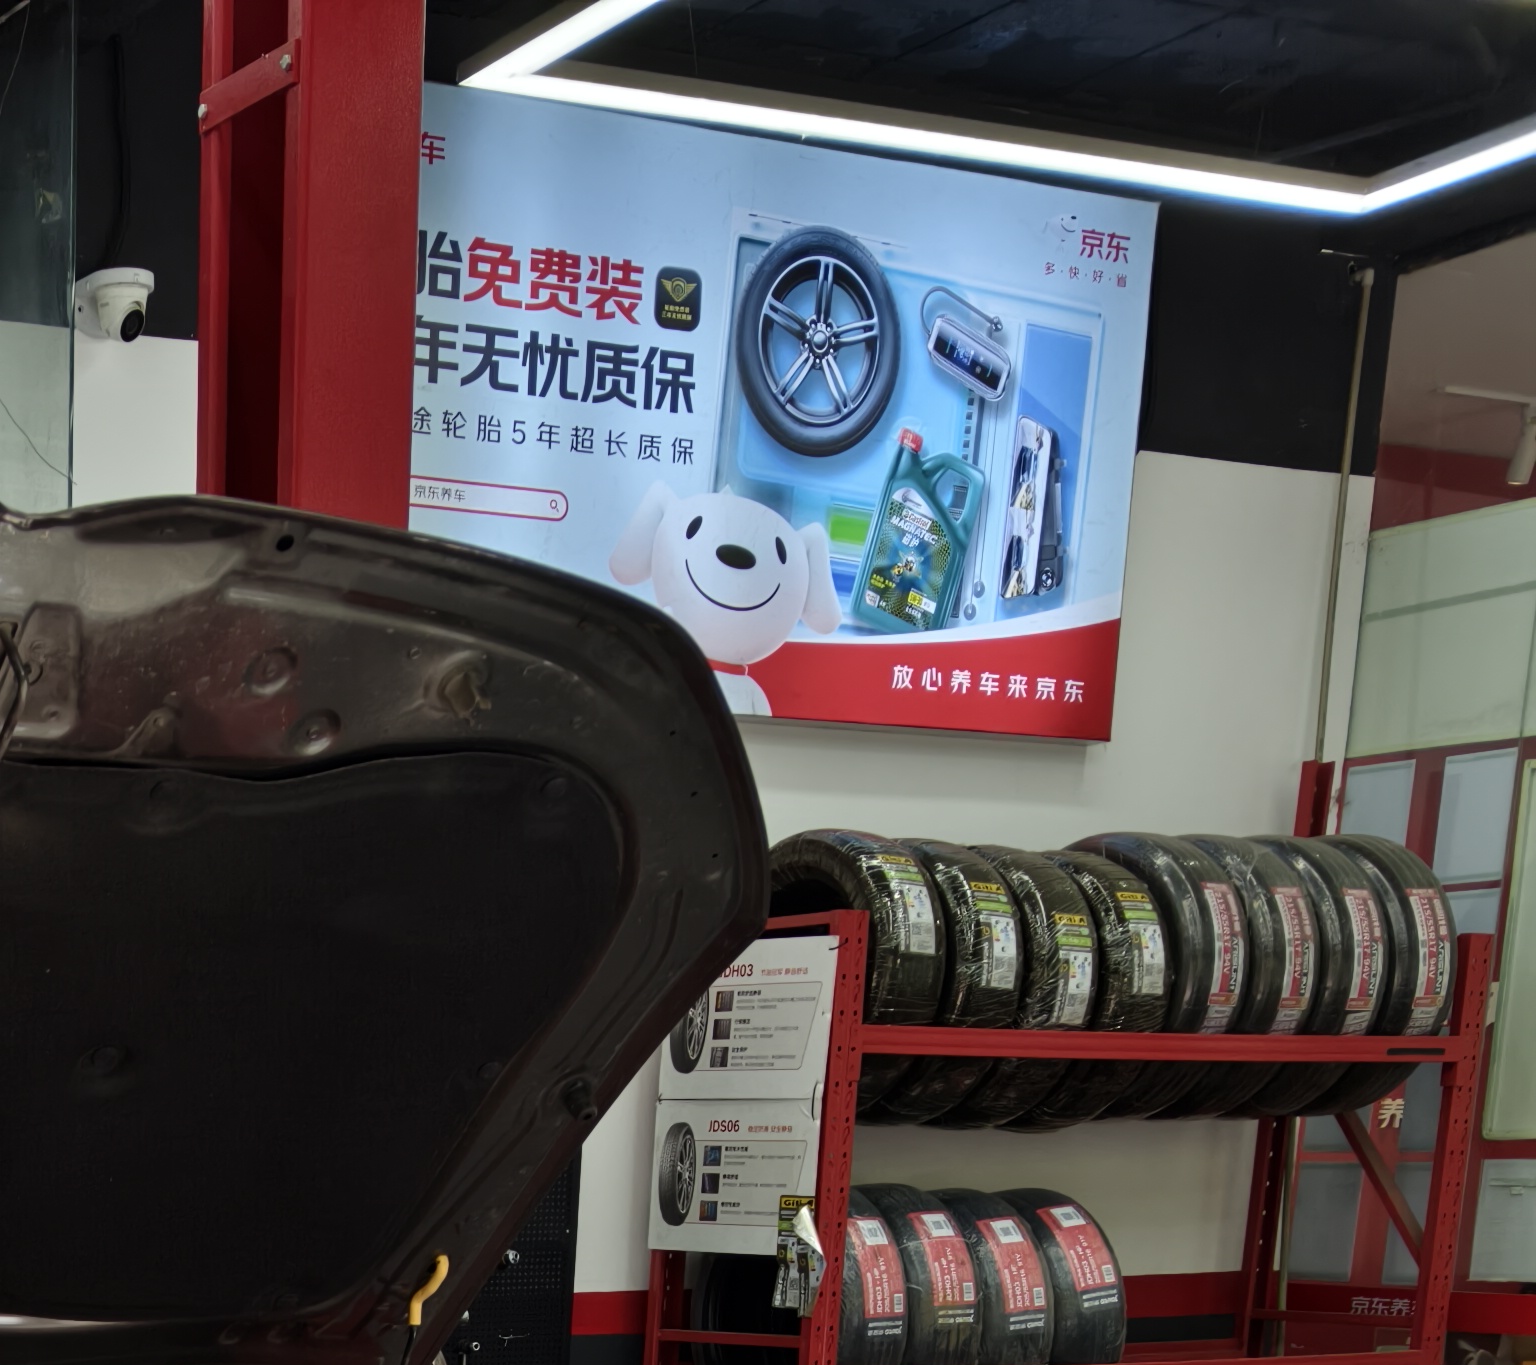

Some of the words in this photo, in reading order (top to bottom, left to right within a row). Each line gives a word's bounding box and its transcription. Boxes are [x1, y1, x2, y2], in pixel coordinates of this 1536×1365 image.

[1080, 229, 1131, 264] 京东
[416, 229, 645, 325] 胎免费装
[414, 315, 696, 414] 年无忧质保
[414, 484, 466, 502] 京东养车
[891, 515, 938, 545] MAGNATEC
[892, 664, 1085, 703] 放心养车来京东
[708, 1119, 740, 1133] JDS06
[1378, 1098, 1405, 1129] 养
[1350, 1296, 1415, 1317] 京东养
